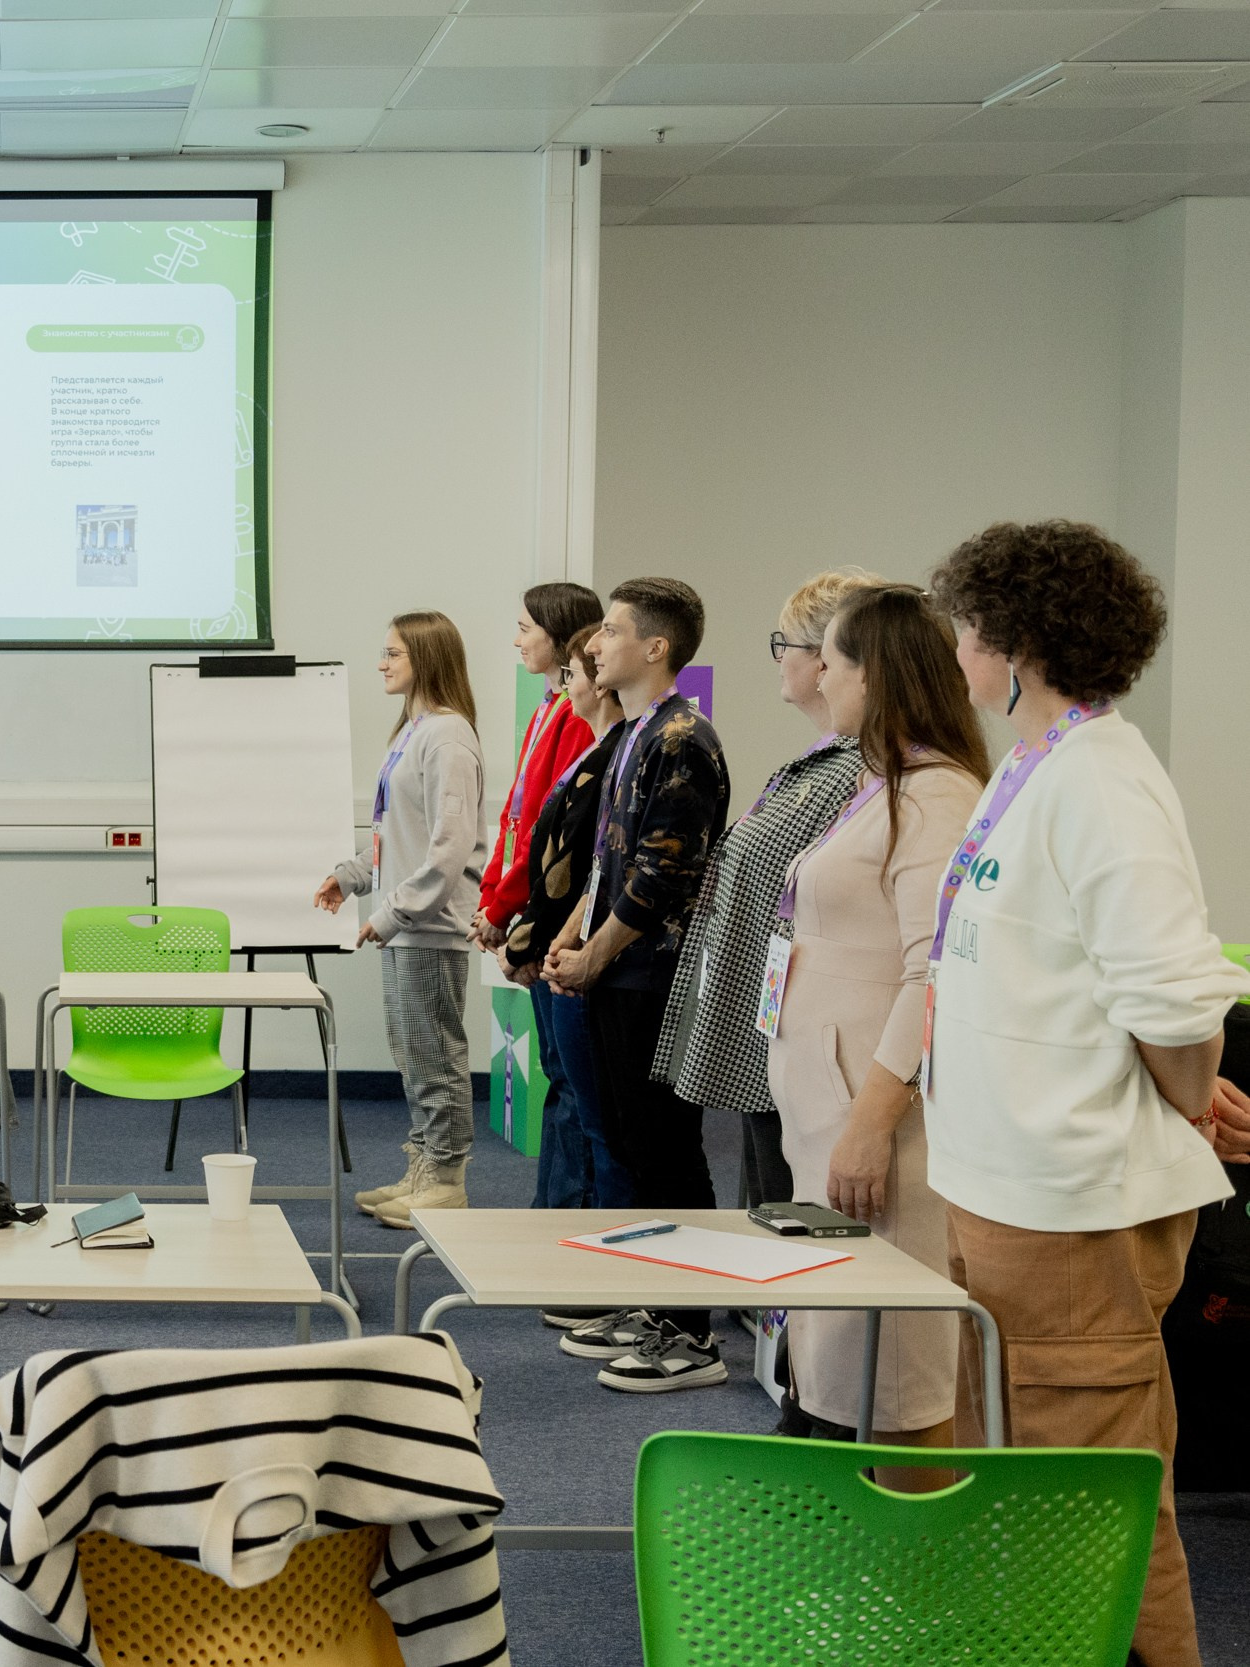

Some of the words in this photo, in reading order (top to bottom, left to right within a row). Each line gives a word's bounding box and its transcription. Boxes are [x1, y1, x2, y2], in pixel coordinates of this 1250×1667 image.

[43, 330, 99, 338] Знакомство
[107, 331, 171, 339] участниками
[51, 376, 125, 385] Представляется
[127, 376, 164, 384] каждый
[50, 388, 94, 396] участник,
[51, 407, 58, 415] В
[51, 429, 72, 437] игра
[125, 428, 153, 436] чтобы
[111, 438, 140, 446] более
[50, 459, 93, 468] барьеры.
